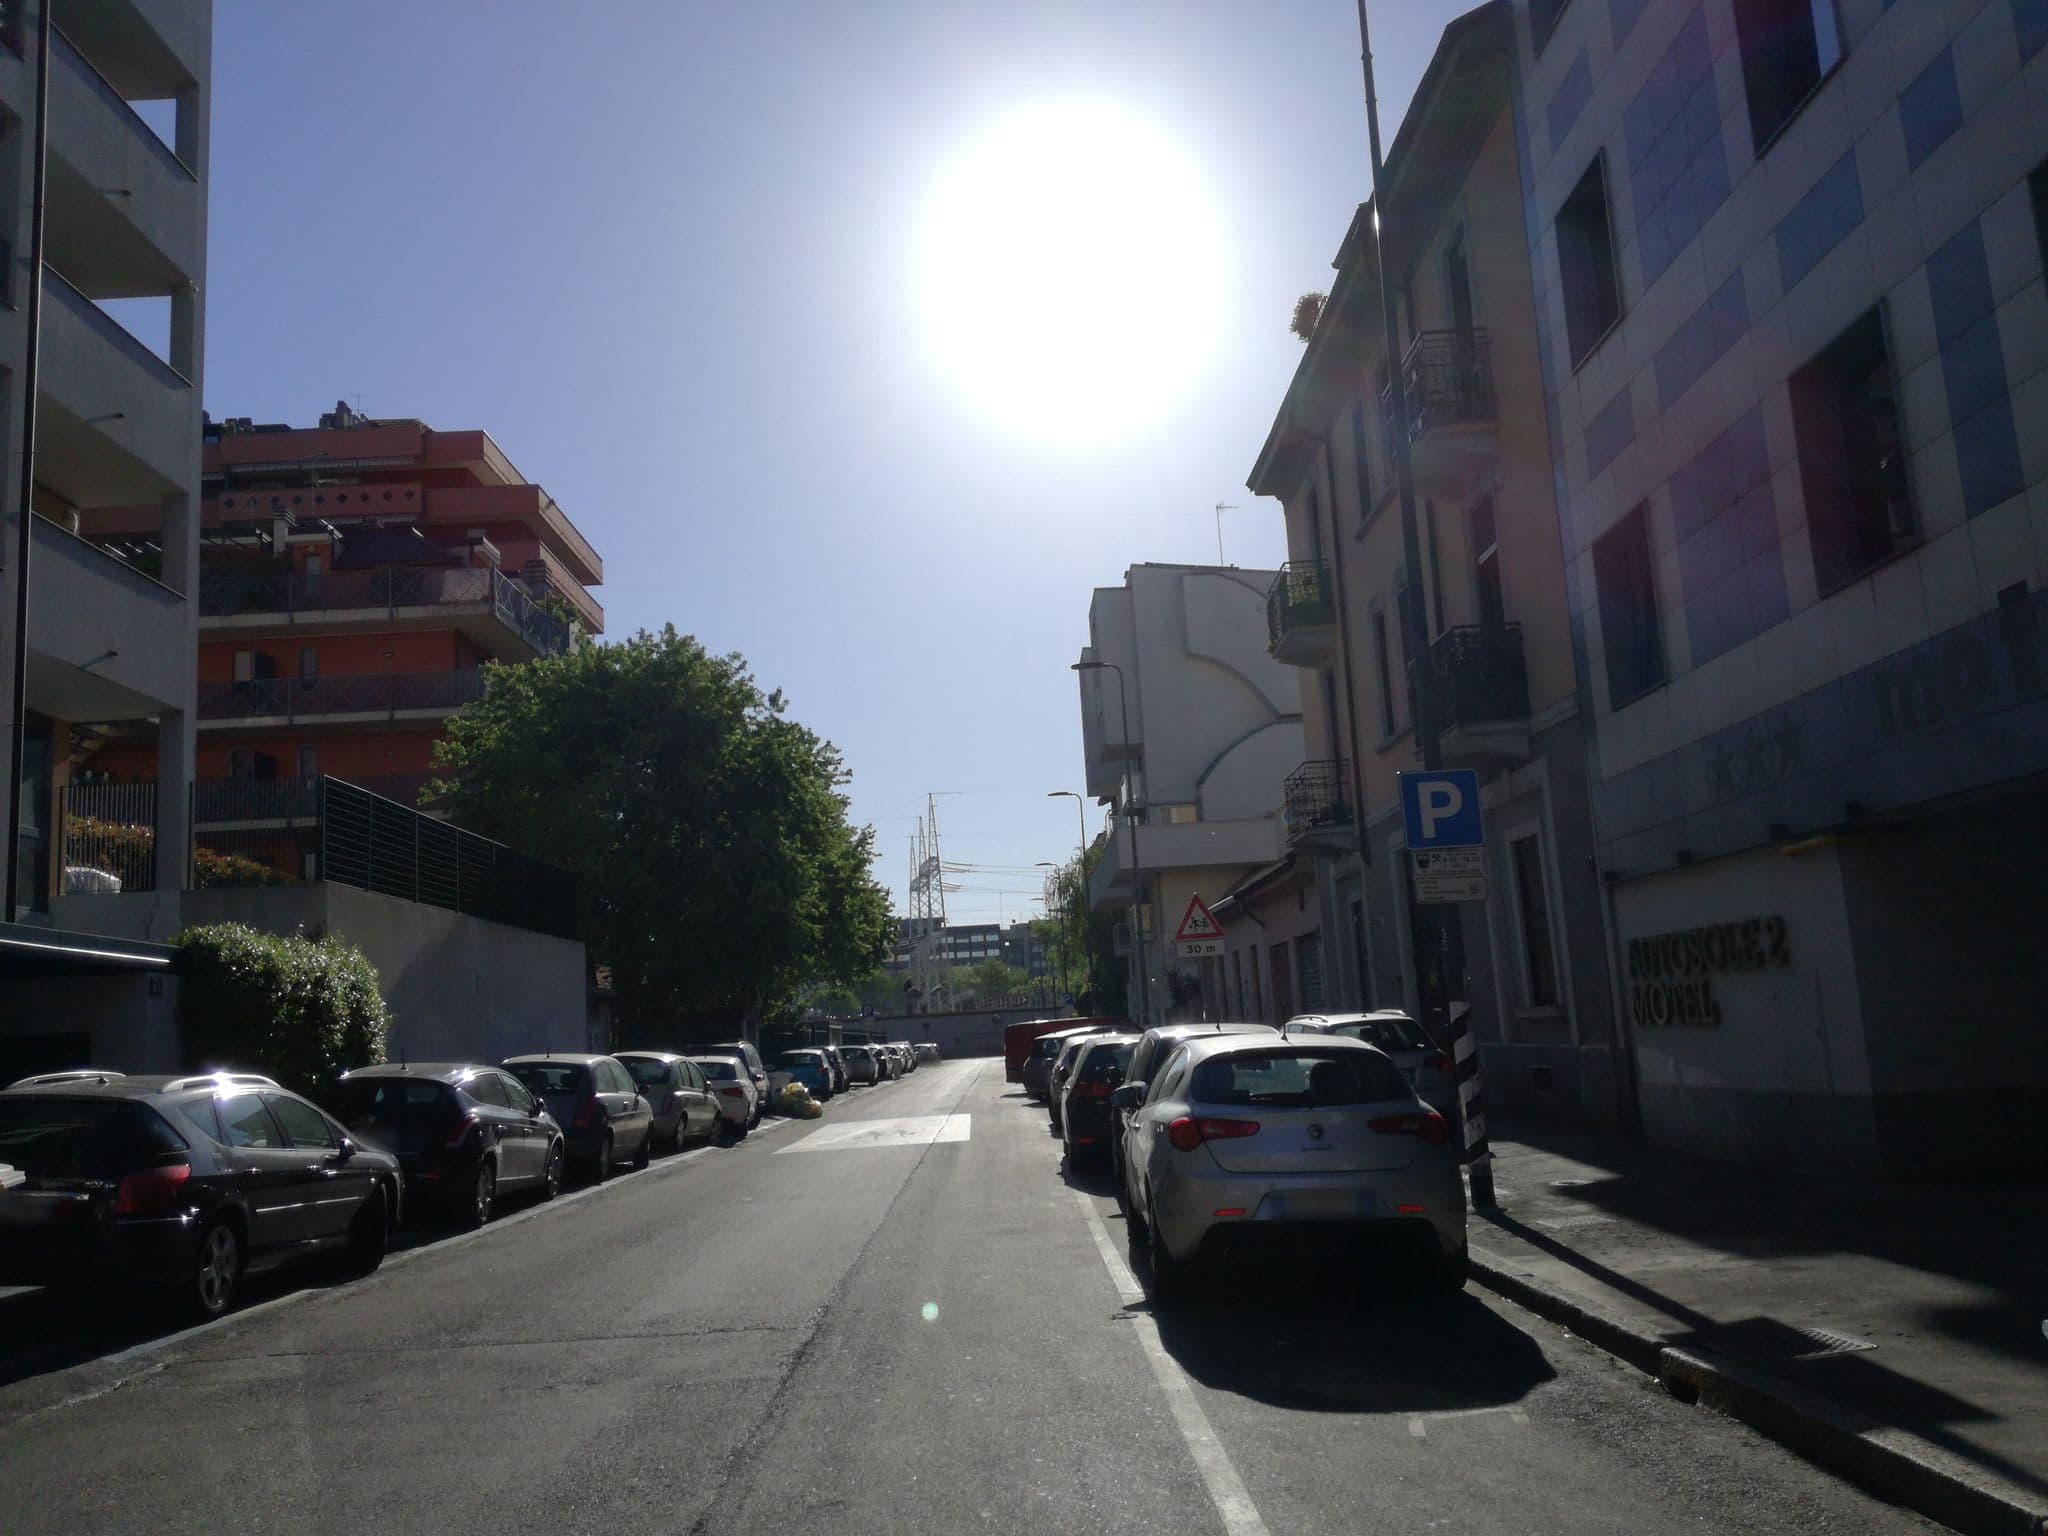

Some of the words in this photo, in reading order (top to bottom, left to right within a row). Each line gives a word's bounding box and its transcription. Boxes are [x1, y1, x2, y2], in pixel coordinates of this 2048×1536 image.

[1417, 781, 1463, 839] P
[1186, 945, 1201, 953] 30
[1632, 978, 1721, 1026] MOTEL
